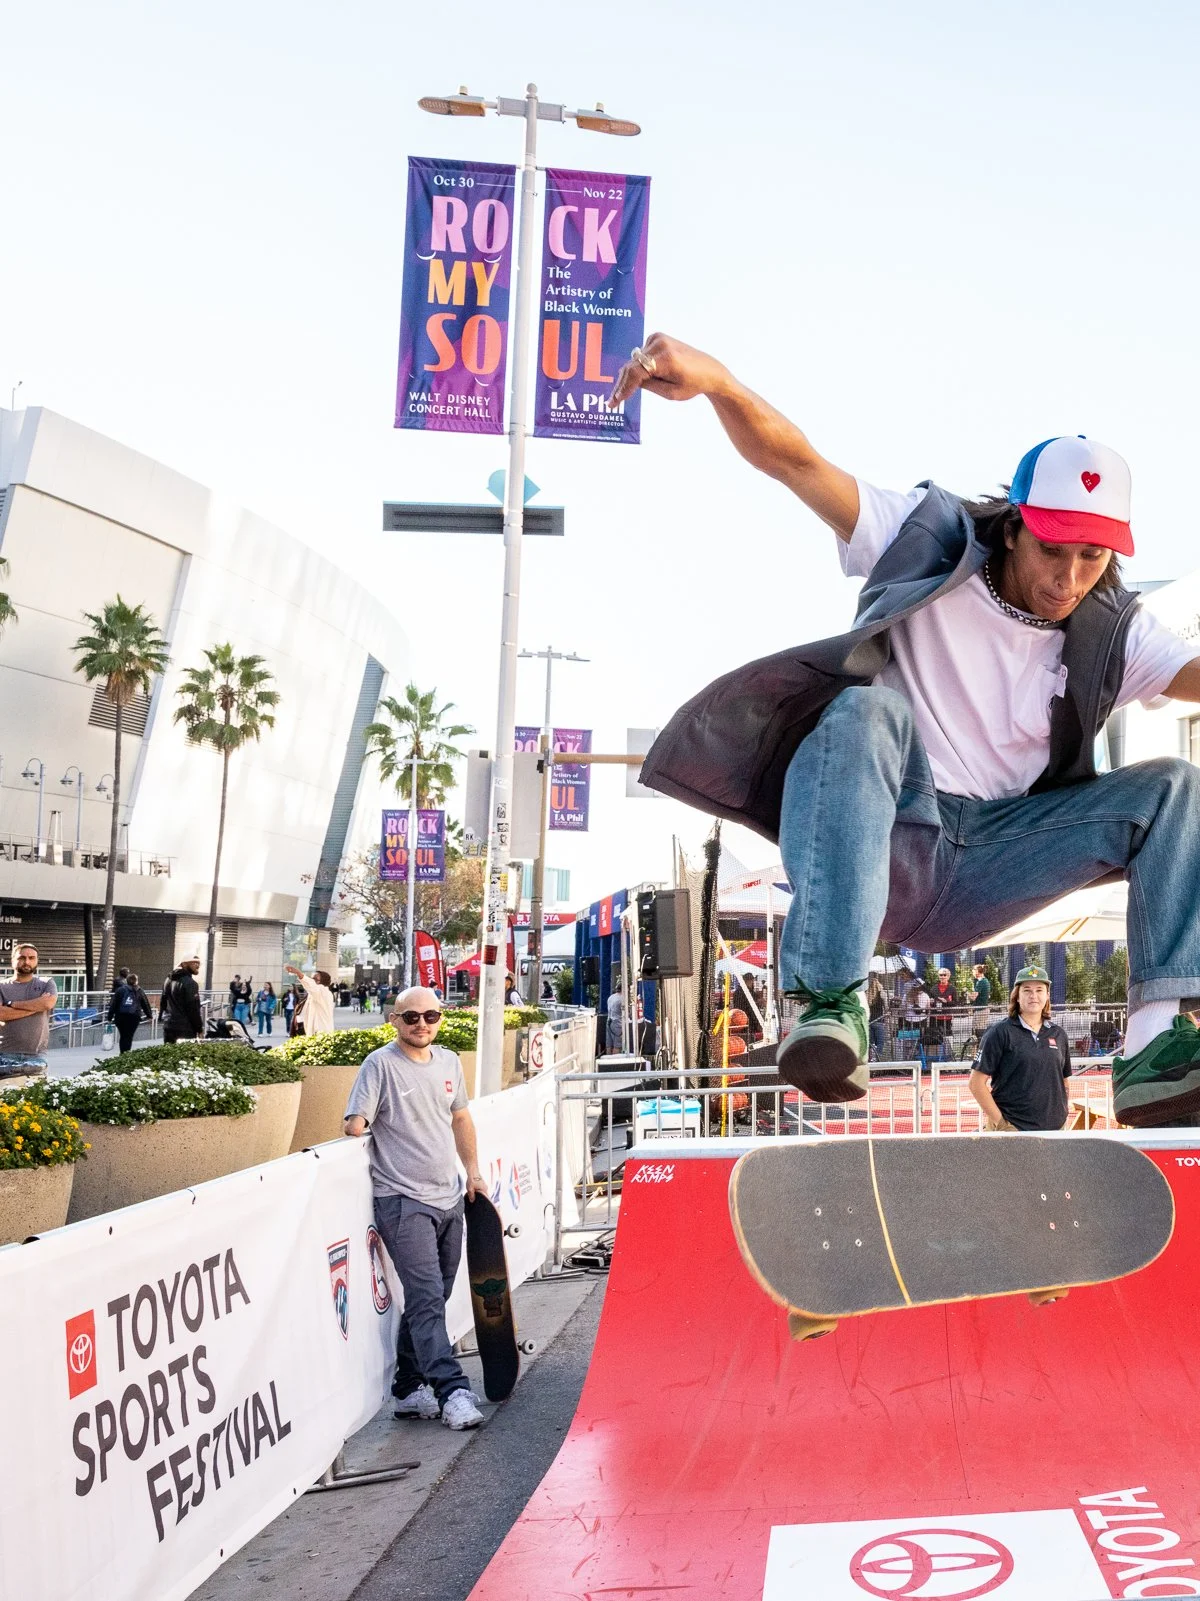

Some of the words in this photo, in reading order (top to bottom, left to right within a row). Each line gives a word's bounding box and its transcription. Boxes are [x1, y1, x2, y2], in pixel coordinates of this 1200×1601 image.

[433, 175, 456, 187] Oct
[458, 177, 474, 188] 30
[583, 187, 606, 199] Nov
[607, 189, 623, 200] 22
[430, 195, 509, 254] RO
[548, 205, 618, 264] CK
[547, 267, 571, 279] The
[427, 258, 500, 307] MY
[545, 284, 596, 299] Artistry
[598, 288, 613, 299] of
[544, 300, 580, 314] Black
[583, 304, 632, 318] Women
[424, 312, 502, 375] SO
[541, 319, 614, 383] UL
[409, 391, 441, 403] WALT
[447, 394, 490, 406] DISNEY
[551, 391, 578, 411] LA
[409, 403, 461, 416] CONCERT
[464, 406, 491, 418] HALL
[551, 411, 586, 419] GUSTAVO
[588, 414, 624, 422] DUDAMEL
[551, 785, 579, 810] UL
[387, 818, 407, 833] RO
[419, 818, 437, 834] CK
[567, 814, 584, 822] Phil
[386, 834, 405, 847] MY
[386, 848, 407, 865] SO
[417, 848, 436, 866] UL
[637, 1165, 675, 1174] KEEN
[631, 1173, 674, 1183] RAMPS
[108, 1248, 250, 1371] TOYOTA
[73, 1345, 216, 1496] SPORTS
[147, 1381, 291, 1542] FESTIVAL
